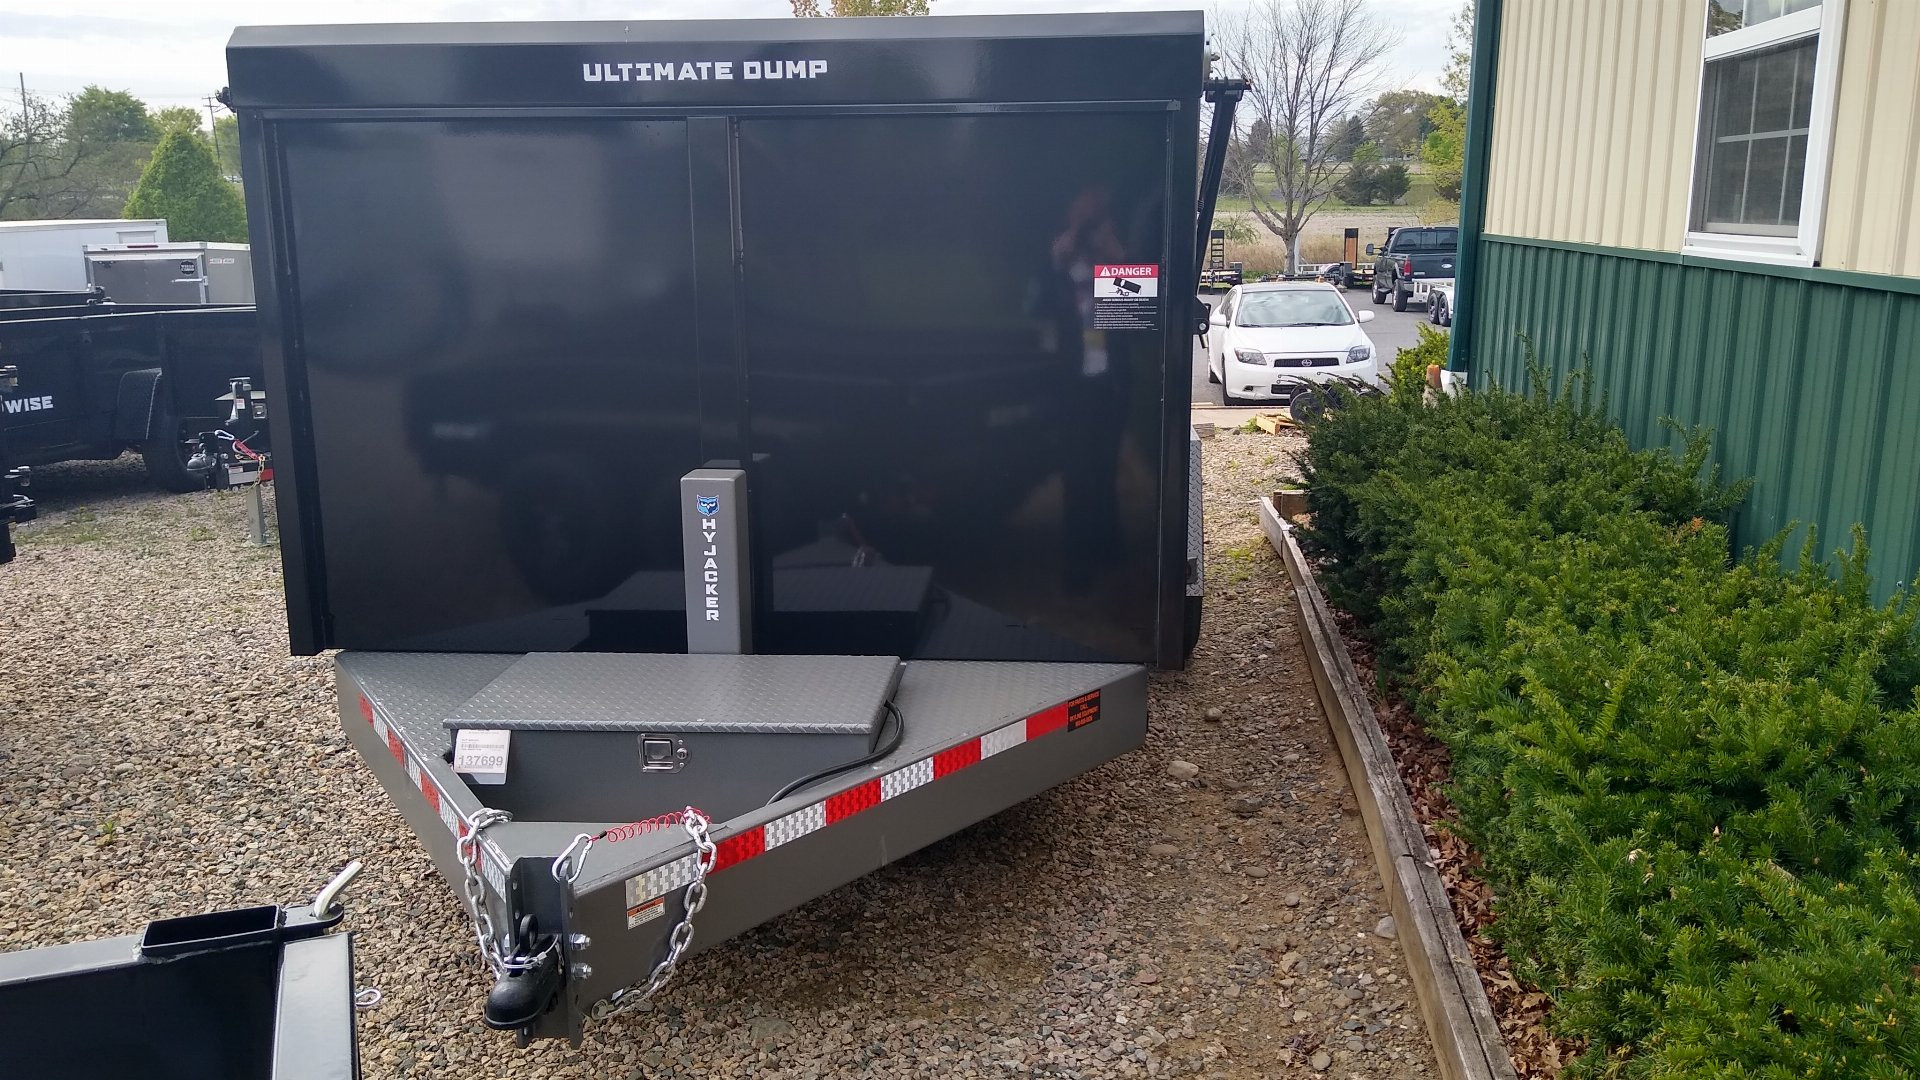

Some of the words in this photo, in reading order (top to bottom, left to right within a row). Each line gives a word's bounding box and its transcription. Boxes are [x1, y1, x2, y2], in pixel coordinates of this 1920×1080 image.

[583, 62, 733, 81] ULTIMATE
[743, 60, 828, 80] DUMP
[1111, 267, 1152, 276] DANGER
[0, 395, 54, 414] WISE
[702, 518, 720, 621] HYJACKER
[458, 755, 504, 767] 137699
